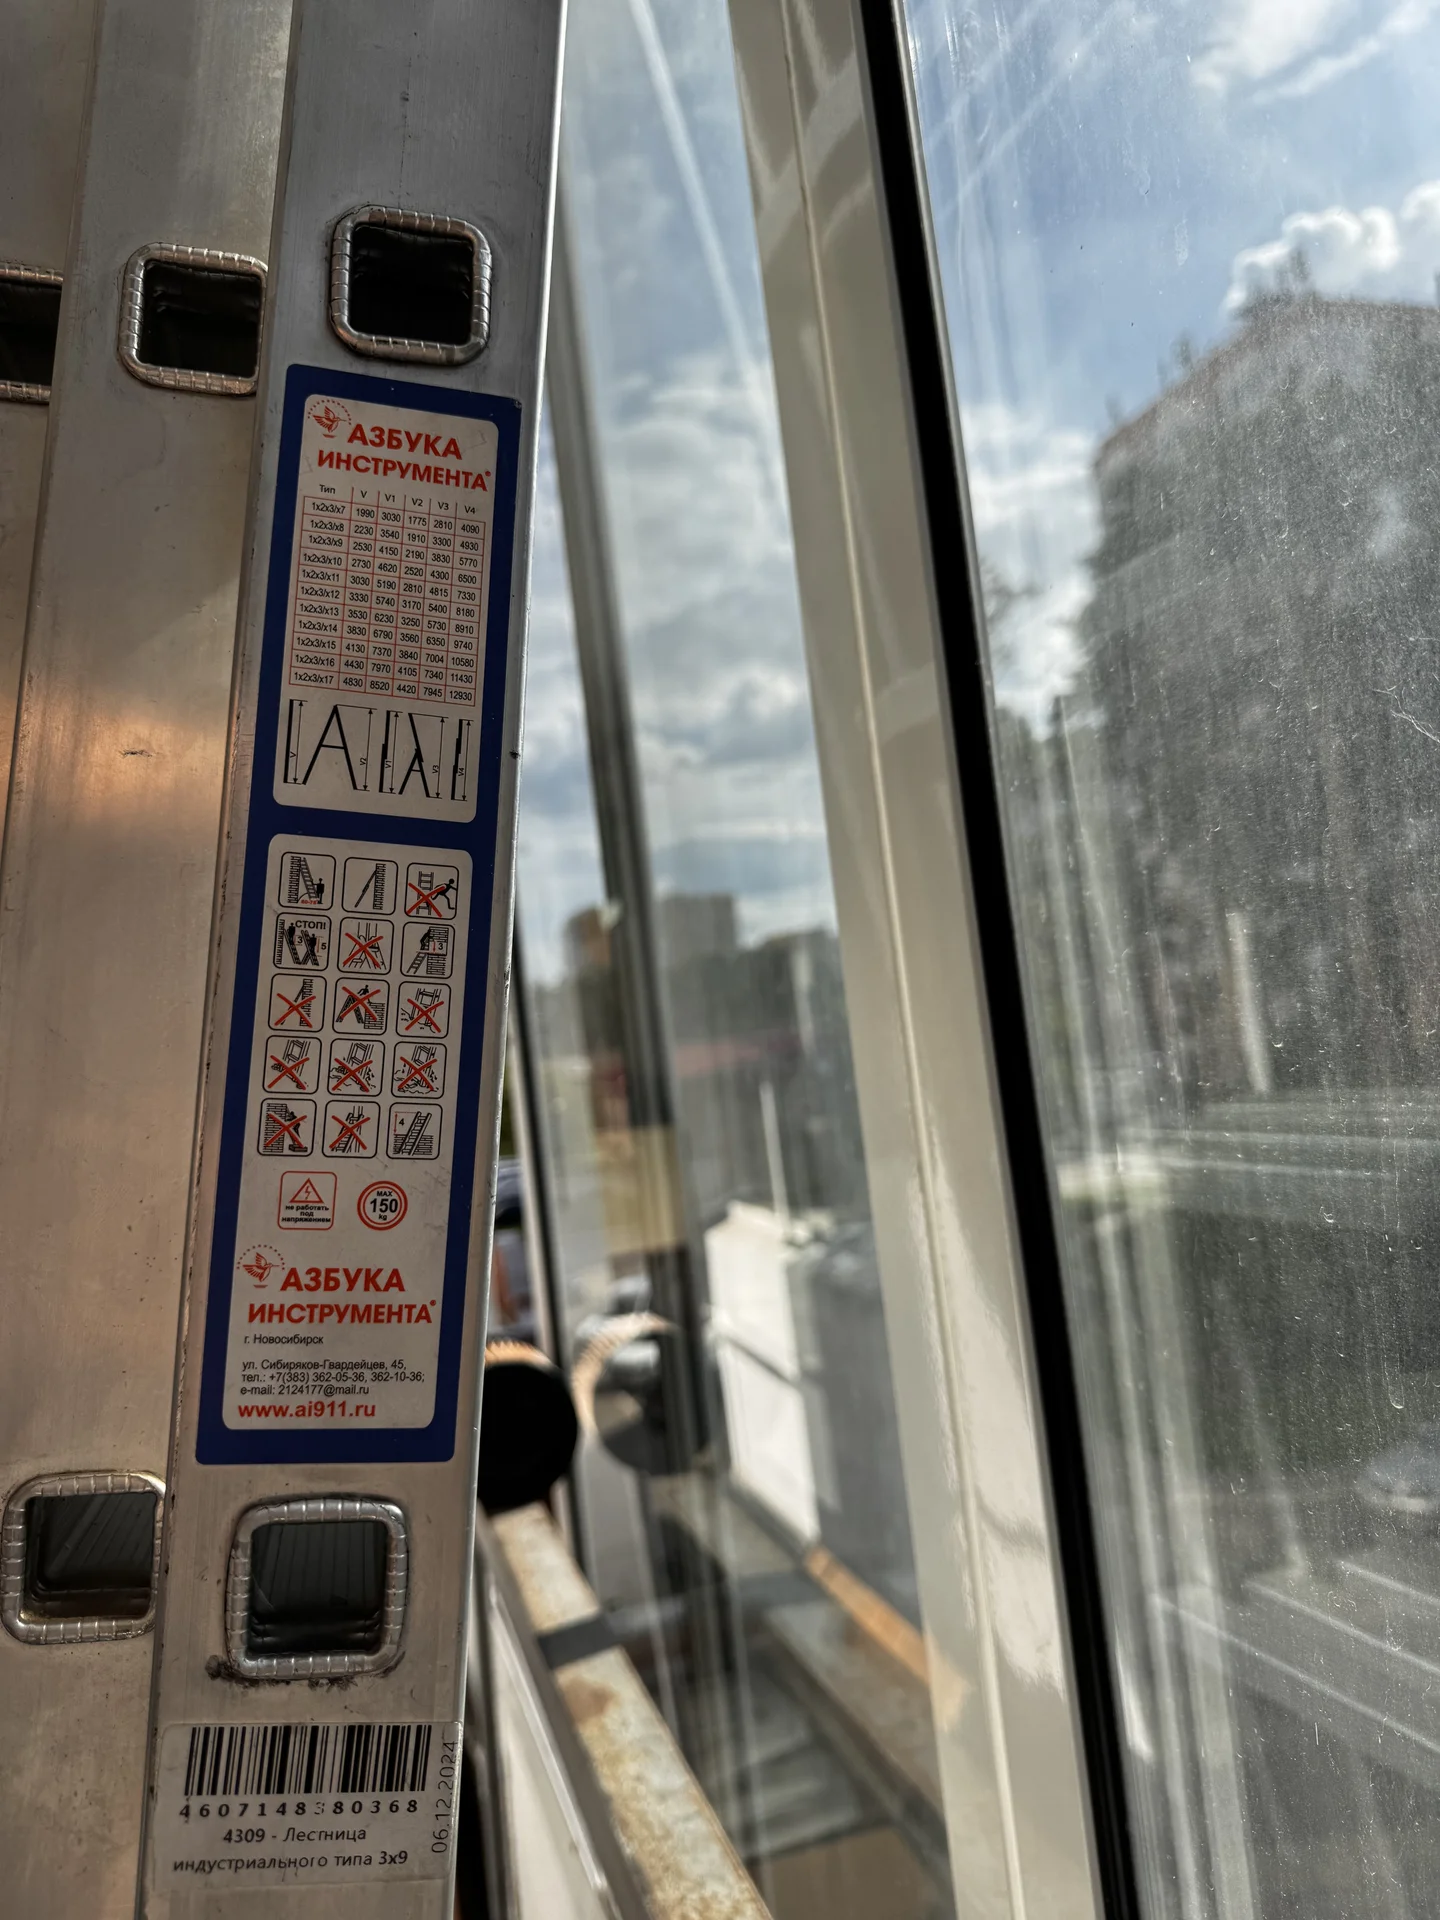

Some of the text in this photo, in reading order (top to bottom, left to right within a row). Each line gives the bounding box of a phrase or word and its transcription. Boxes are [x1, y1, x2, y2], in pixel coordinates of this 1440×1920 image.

[347, 423, 463, 461] АЗБУКА
[317, 449, 488, 492] ИНСТРУМЕНТА
[319, 484, 476, 514] Тип V V1 V2 V3 V4
[356, 508, 375, 519] 1990
[381, 511, 401, 523] 3030
[408, 516, 427, 527] 1775
[433, 519, 453, 530] 2810
[461, 523, 480, 535] 4090
[354, 524, 374, 536] 2230
[380, 528, 400, 540] 3540
[407, 533, 426, 544] 1910
[432, 536, 452, 547] 3300
[460, 540, 479, 552] 4930
[352, 541, 373, 552] 2530
[378, 545, 399, 557] 4150
[405, 548, 425, 560] 2190
[431, 552, 451, 564] 3830
[459, 556, 478, 568] 5770
[351, 558, 371, 569] 2730
[377, 562, 398, 573] 4620
[404, 565, 424, 577] 2520
[430, 570, 450, 581] 4300
[458, 573, 477, 585] 6500
[350, 575, 370, 587] 3030
[376, 579, 397, 590] 5190
[403, 582, 423, 594] 2810
[429, 586, 449, 598] 4815
[457, 590, 476, 602] 7330
[348, 592, 369, 603] 3330
[375, 595, 395, 607] 5740
[401, 599, 422, 611] 3170
[428, 603, 448, 614] 5400
[455, 606, 475, 618] 8180
[347, 608, 368, 620] 3530
[374, 612, 394, 624] 6230
[400, 616, 421, 628] 3250
[427, 620, 447, 631] 5730
[454, 623, 474, 635] 8910
[346, 625, 367, 636] 3830
[373, 629, 393, 640] 6790
[399, 632, 420, 644] 3560
[426, 636, 446, 647] 6350
[453, 639, 473, 651] 9740
[345, 643, 366, 654] 4130
[372, 645, 392, 657] 7370
[398, 649, 419, 661] 3840
[425, 653, 444, 664] 7004
[451, 656, 474, 668] 10580
[344, 659, 364, 670] 4430
[371, 662, 391, 674] 7970
[397, 666, 417, 677] 4105
[424, 669, 444, 681] 7340
[450, 673, 473, 684] 11430
[342, 677, 363, 688] 4830
[369, 680, 390, 691] 8520
[396, 683, 416, 695] 4420
[423, 686, 443, 698] 7945
[449, 690, 473, 701] 12930
[432, 764, 439, 774] V3
[295, 920, 326, 930] СТОП!
[297, 936, 303, 944] 3
[437, 942, 444, 950] 3
[399, 1118, 404, 1126] 4
[296, 1204, 329, 1212] работать
[370, 1198, 398, 1213] 150
[280, 1267, 405, 1292] АЗБУКА
[247, 1303, 432, 1324] ИНСТРУМЕНТА
[244, 1334, 324, 1345] г. Новосибирск
[242, 1359, 406, 1371] ул. Сибиряков-Гвардейцев, 45,
[241, 1372, 425, 1384] тел.: +7(383) 362-05-36, 362-10-36;
[240, 1384, 370, 1397] e-mail: 2124177@mail.ru
[238, 1401, 376, 1418] www.ai911.ru
[432, 1741, 458, 1854] 06.12.2024
[223, 1828, 265, 1843] 4309
[283, 1827, 367, 1844] Лестница
[334, 1854, 373, 1868] типа
